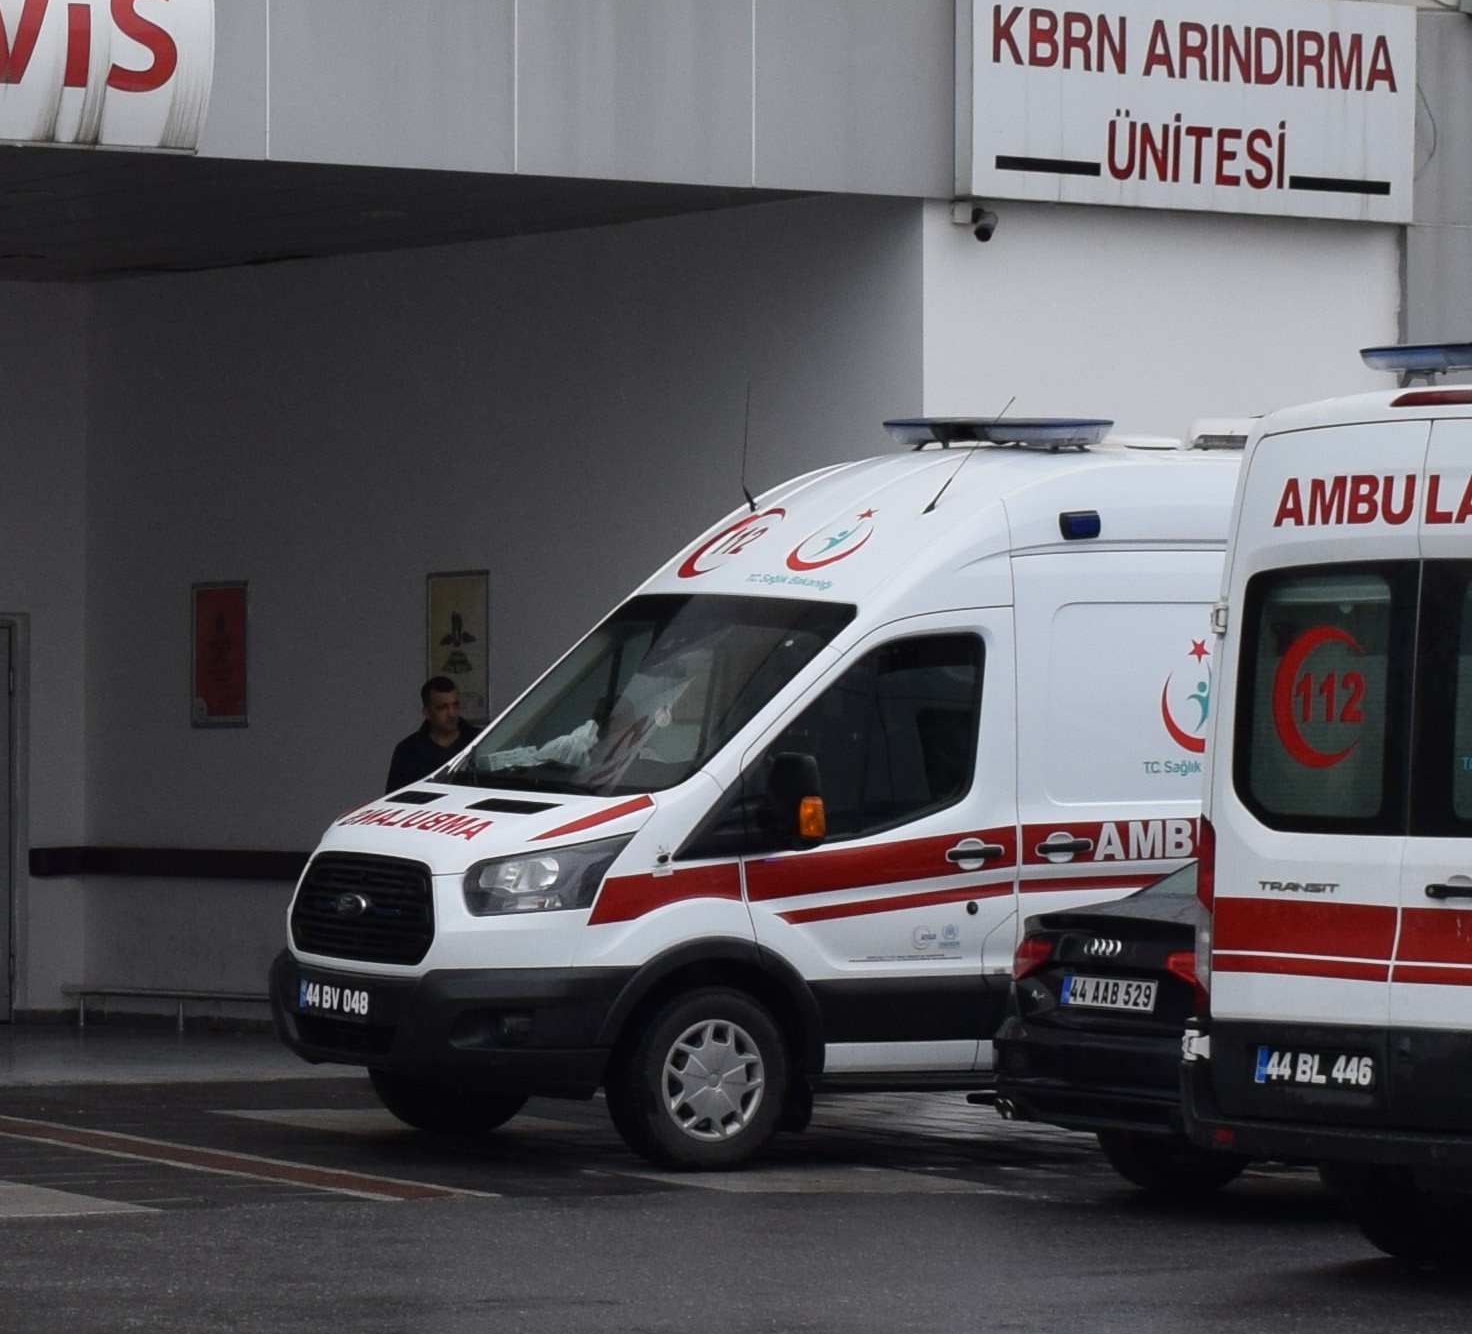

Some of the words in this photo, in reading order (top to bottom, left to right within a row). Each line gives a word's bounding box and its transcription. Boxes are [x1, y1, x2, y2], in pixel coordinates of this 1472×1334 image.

[992, 4, 1127, 75] KBRN
[1142, 18, 1398, 93] ARINDIRMA
[1107, 109, 1287, 190] ÜNİTESİ
[1295, 671, 1365, 725] 112
[1093, 818, 1201, 862] AMB
[1258, 880, 1340, 894] TRANSIT
[306, 983, 321, 1007] 44
[322, 986, 341, 1011] BV
[342, 989, 369, 1015] 048
[1069, 979, 1087, 1003] 44
[1091, 980, 1120, 1005] AAB
[1122, 982, 1152, 1008] 529
[1267, 1051, 1292, 1081] 44
[1295, 1053, 1327, 1085] BL
[1331, 1055, 1374, 1087] 446
